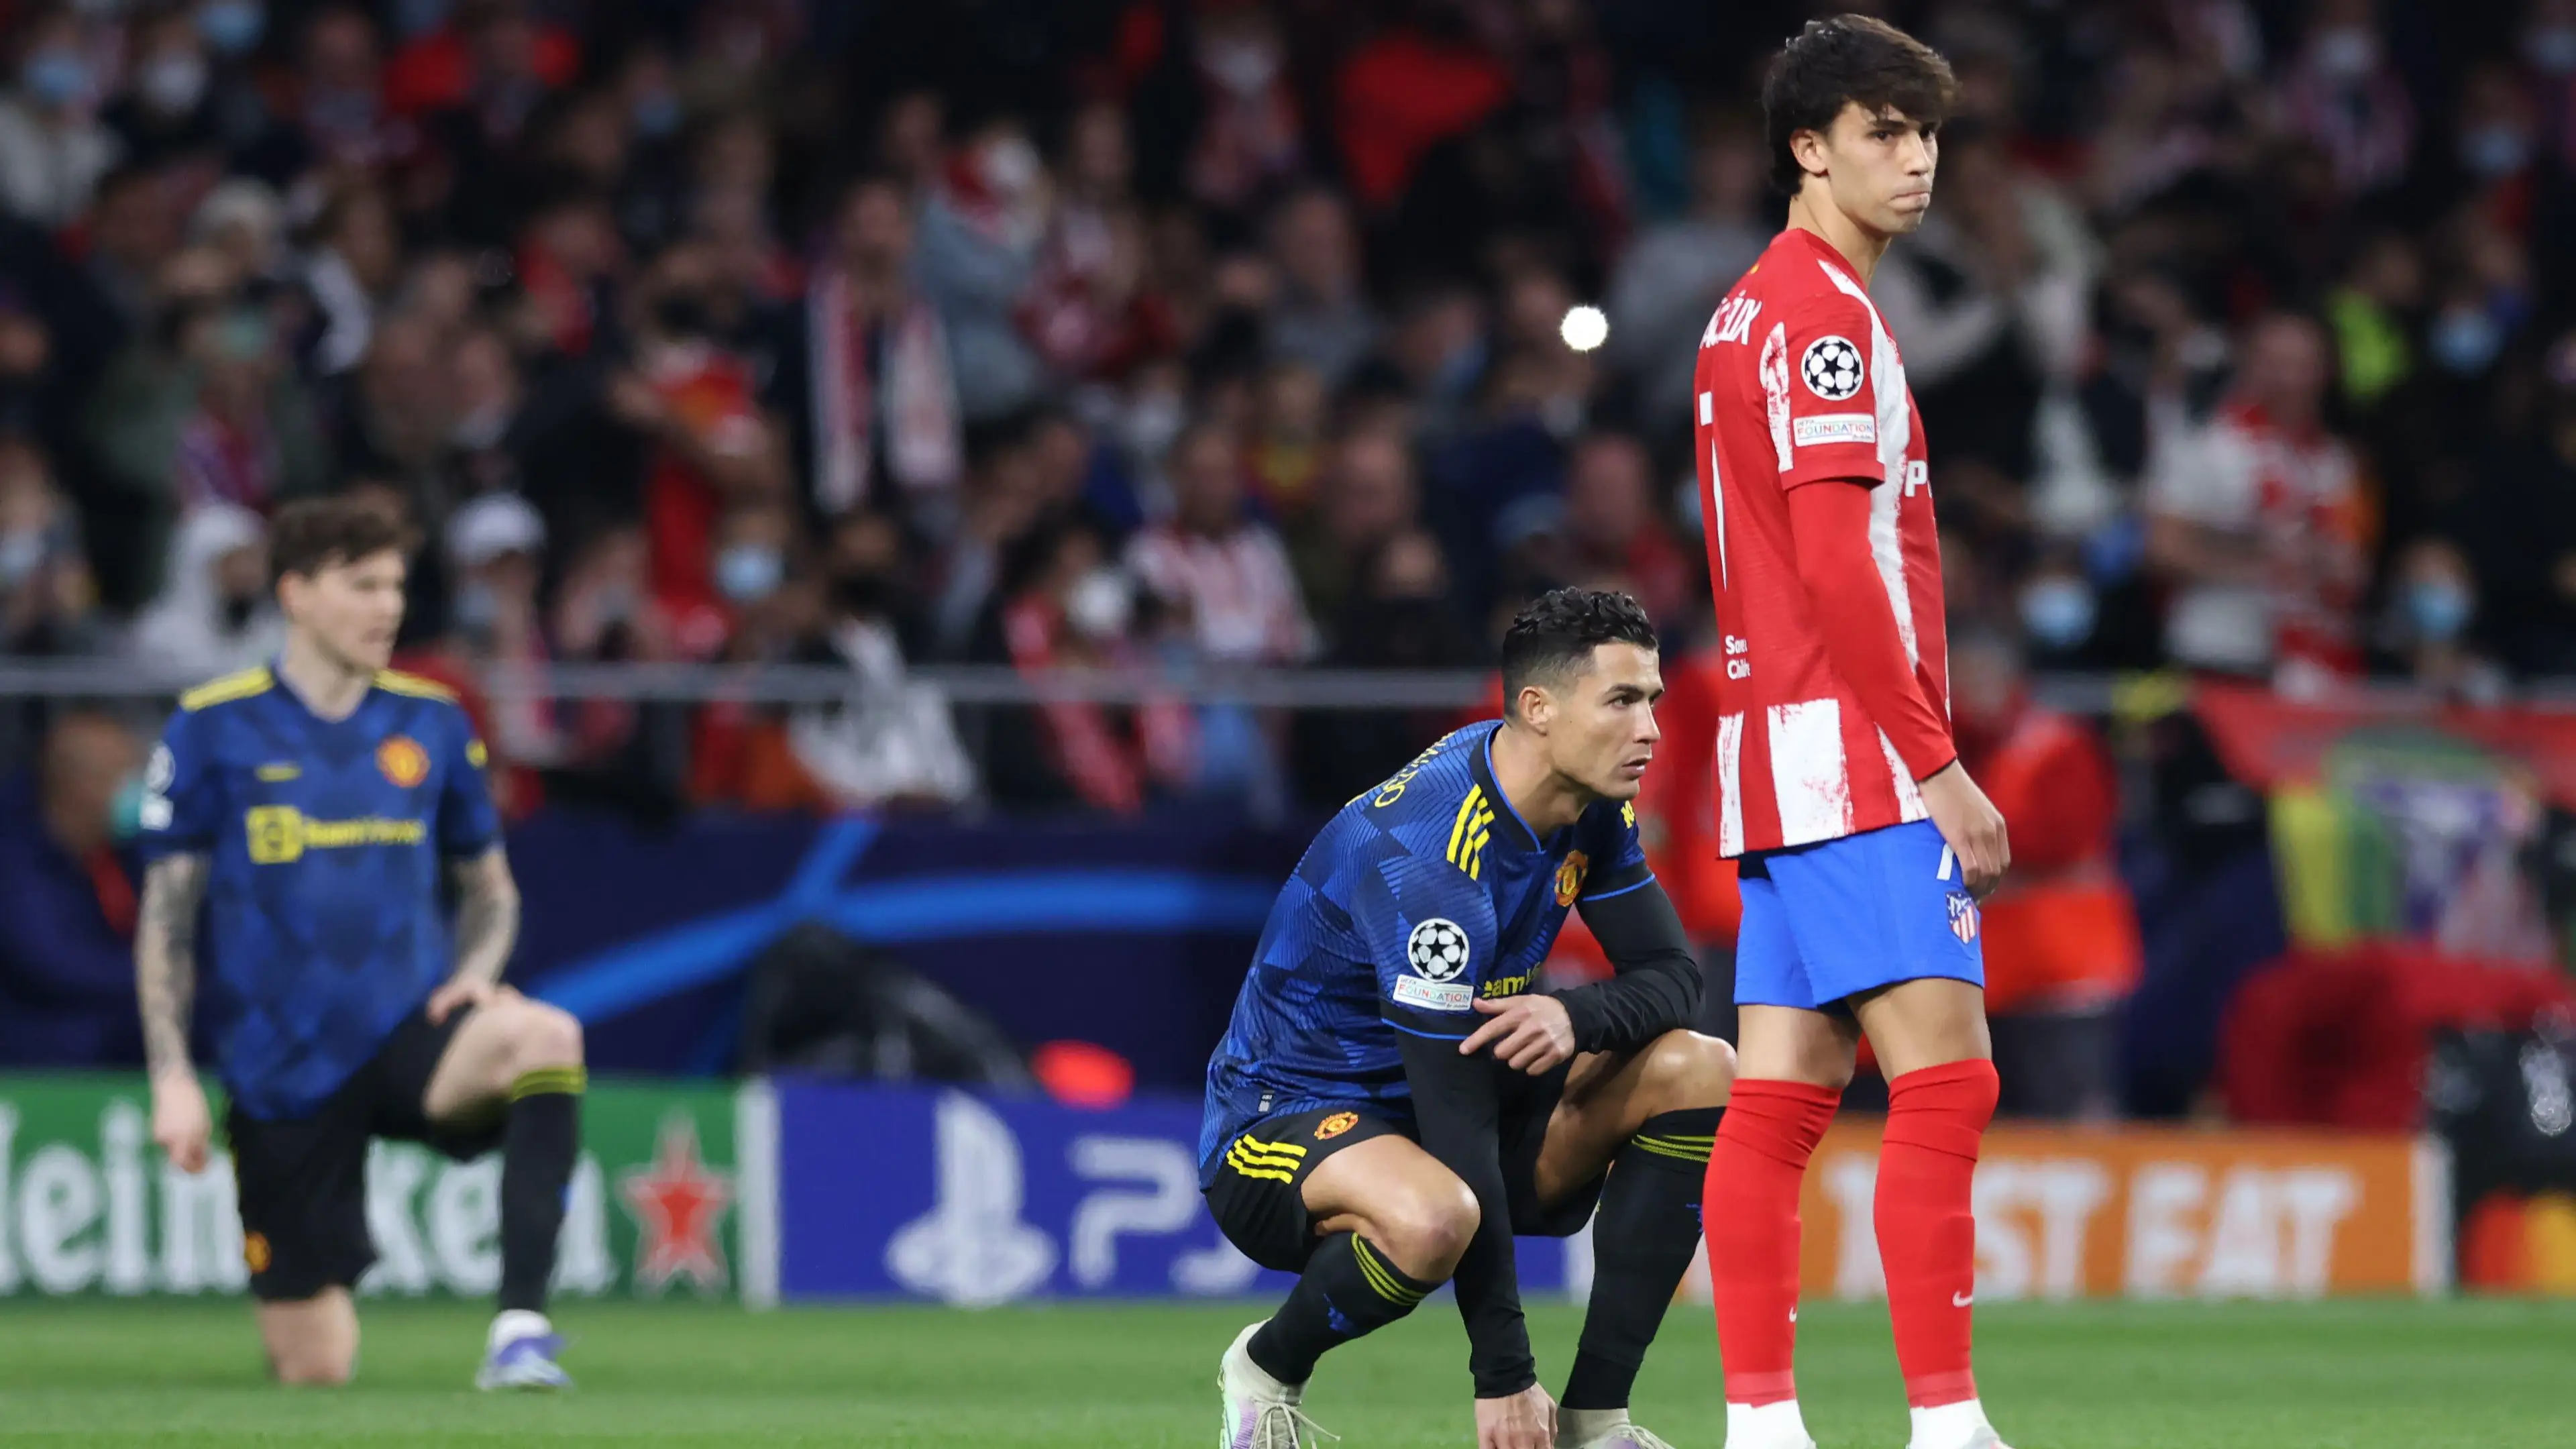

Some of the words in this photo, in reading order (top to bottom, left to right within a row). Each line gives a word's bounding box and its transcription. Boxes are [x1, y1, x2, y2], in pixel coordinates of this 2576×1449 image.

[1798, 422, 1873, 435] FOUNDATION
[1398, 983, 1471, 1002] FOUNDATION
[2123, 1159, 2360, 1299] EAT
